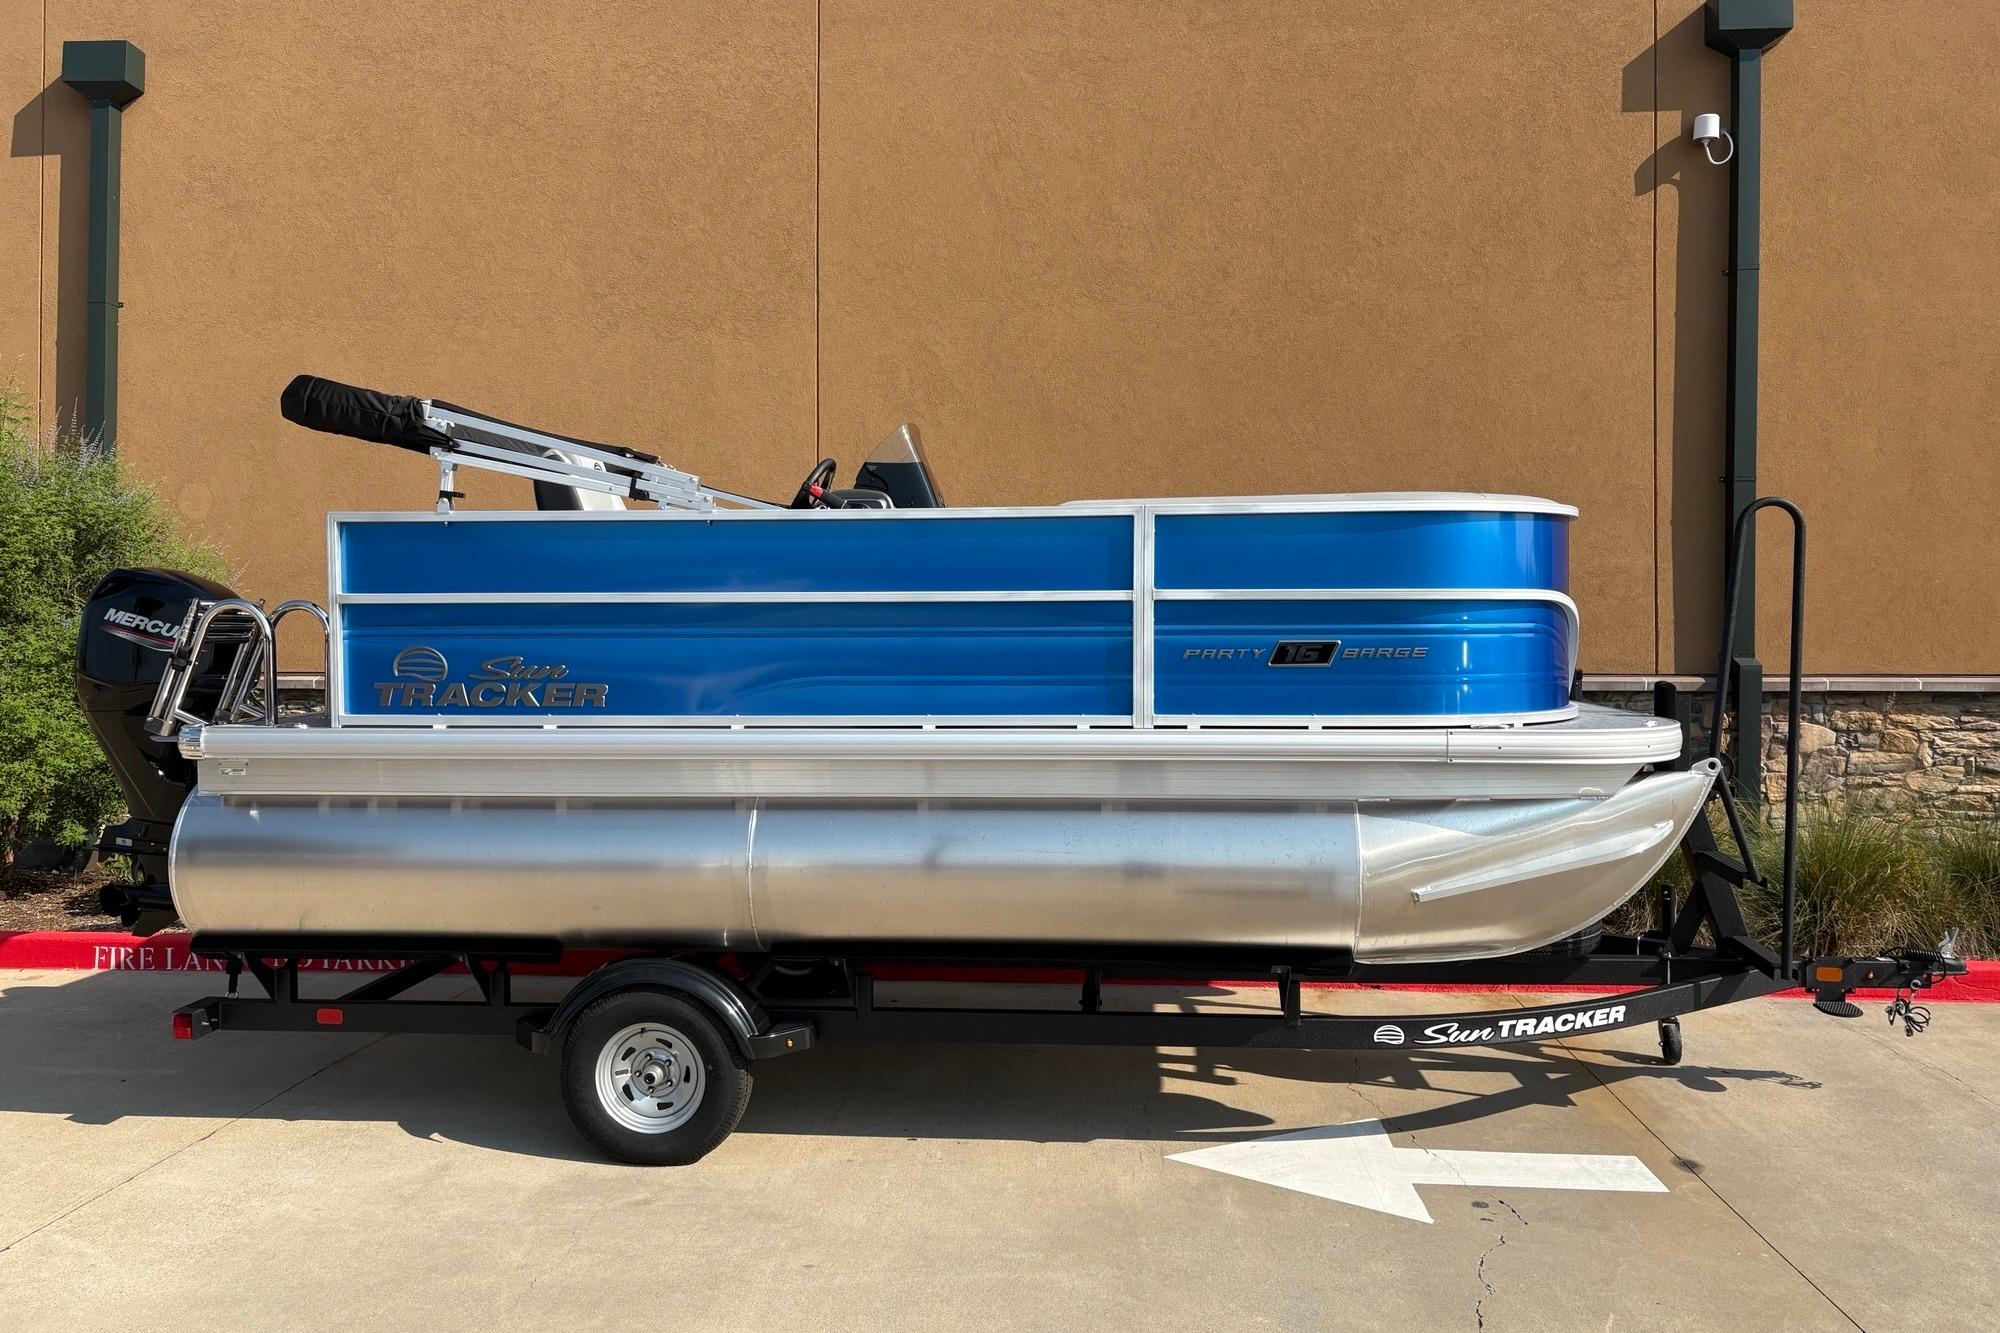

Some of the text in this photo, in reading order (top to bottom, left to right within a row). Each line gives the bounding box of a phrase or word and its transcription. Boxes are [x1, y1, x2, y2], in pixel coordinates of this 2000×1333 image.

[104, 608, 181, 638] MERCU
[1182, 644, 1429, 662] PARTY 16 BARGE
[469, 655, 569, 680] Sun
[373, 682, 609, 708] TRACKER
[93, 946, 155, 970] FIRE
[1413, 1005, 1626, 1044] Sun TRACKER
